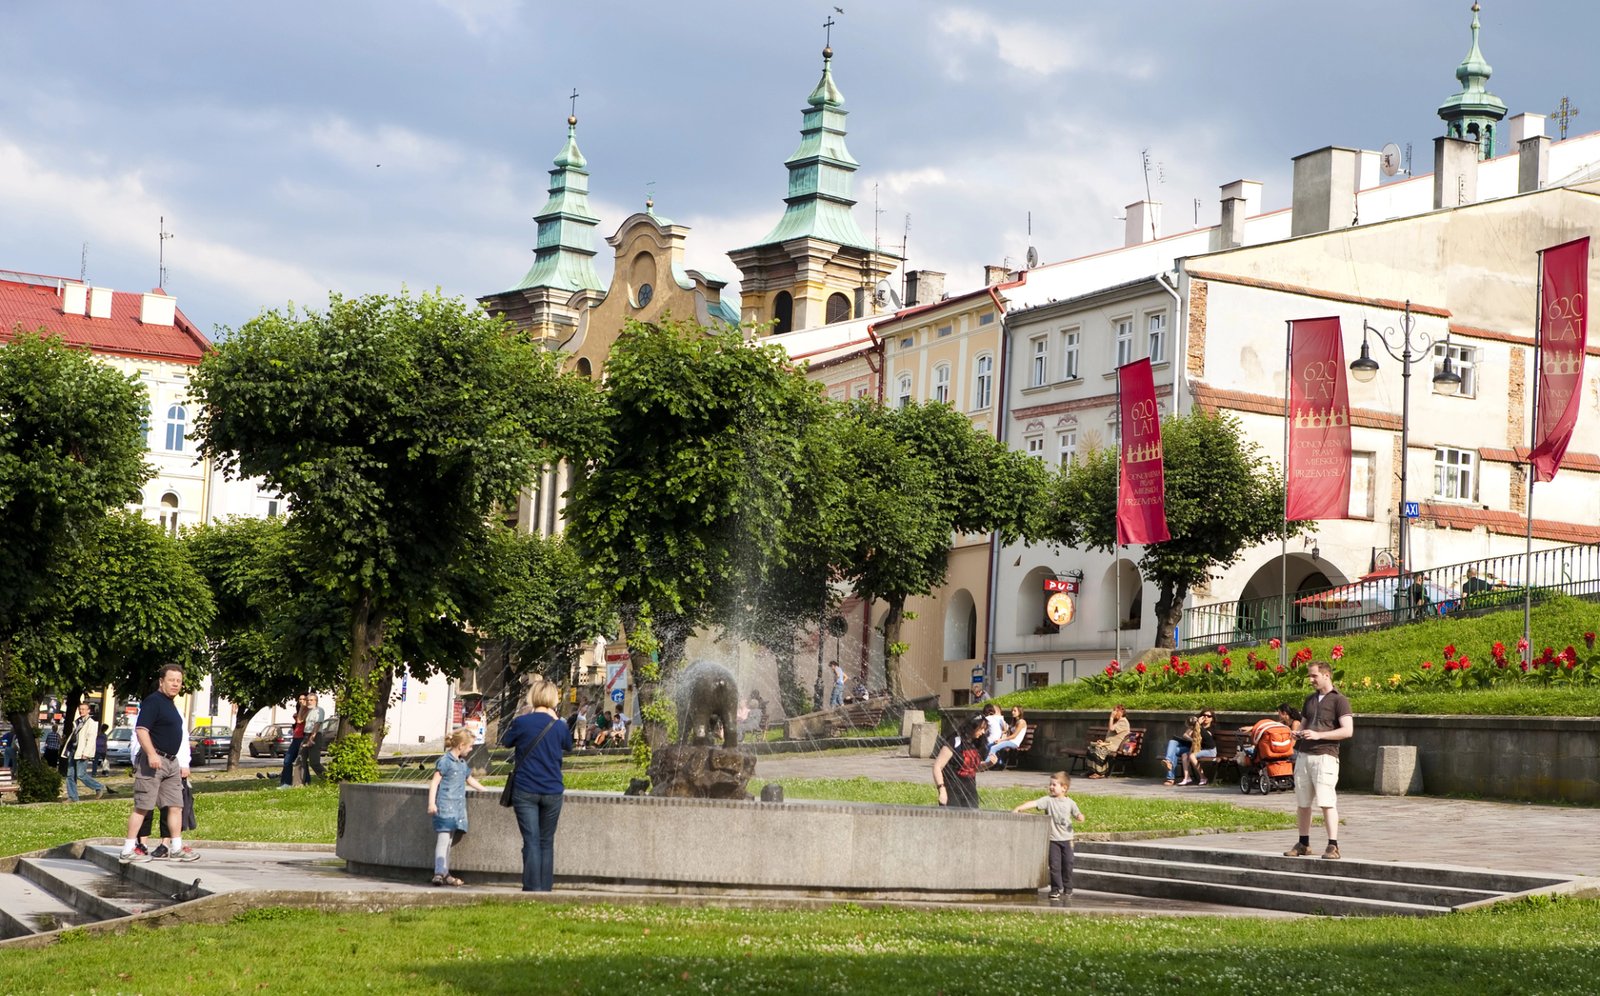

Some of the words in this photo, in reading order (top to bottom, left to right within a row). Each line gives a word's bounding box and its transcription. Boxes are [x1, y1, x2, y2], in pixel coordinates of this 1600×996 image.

[1548, 318, 1584, 341] LAT
[1304, 381, 1336, 400] LAT
[1131, 399, 1154, 420] 620
[1133, 418, 1154, 437] LAT
[1405, 503, 1419, 516] AXI
[1049, 581, 1074, 591] PUB
